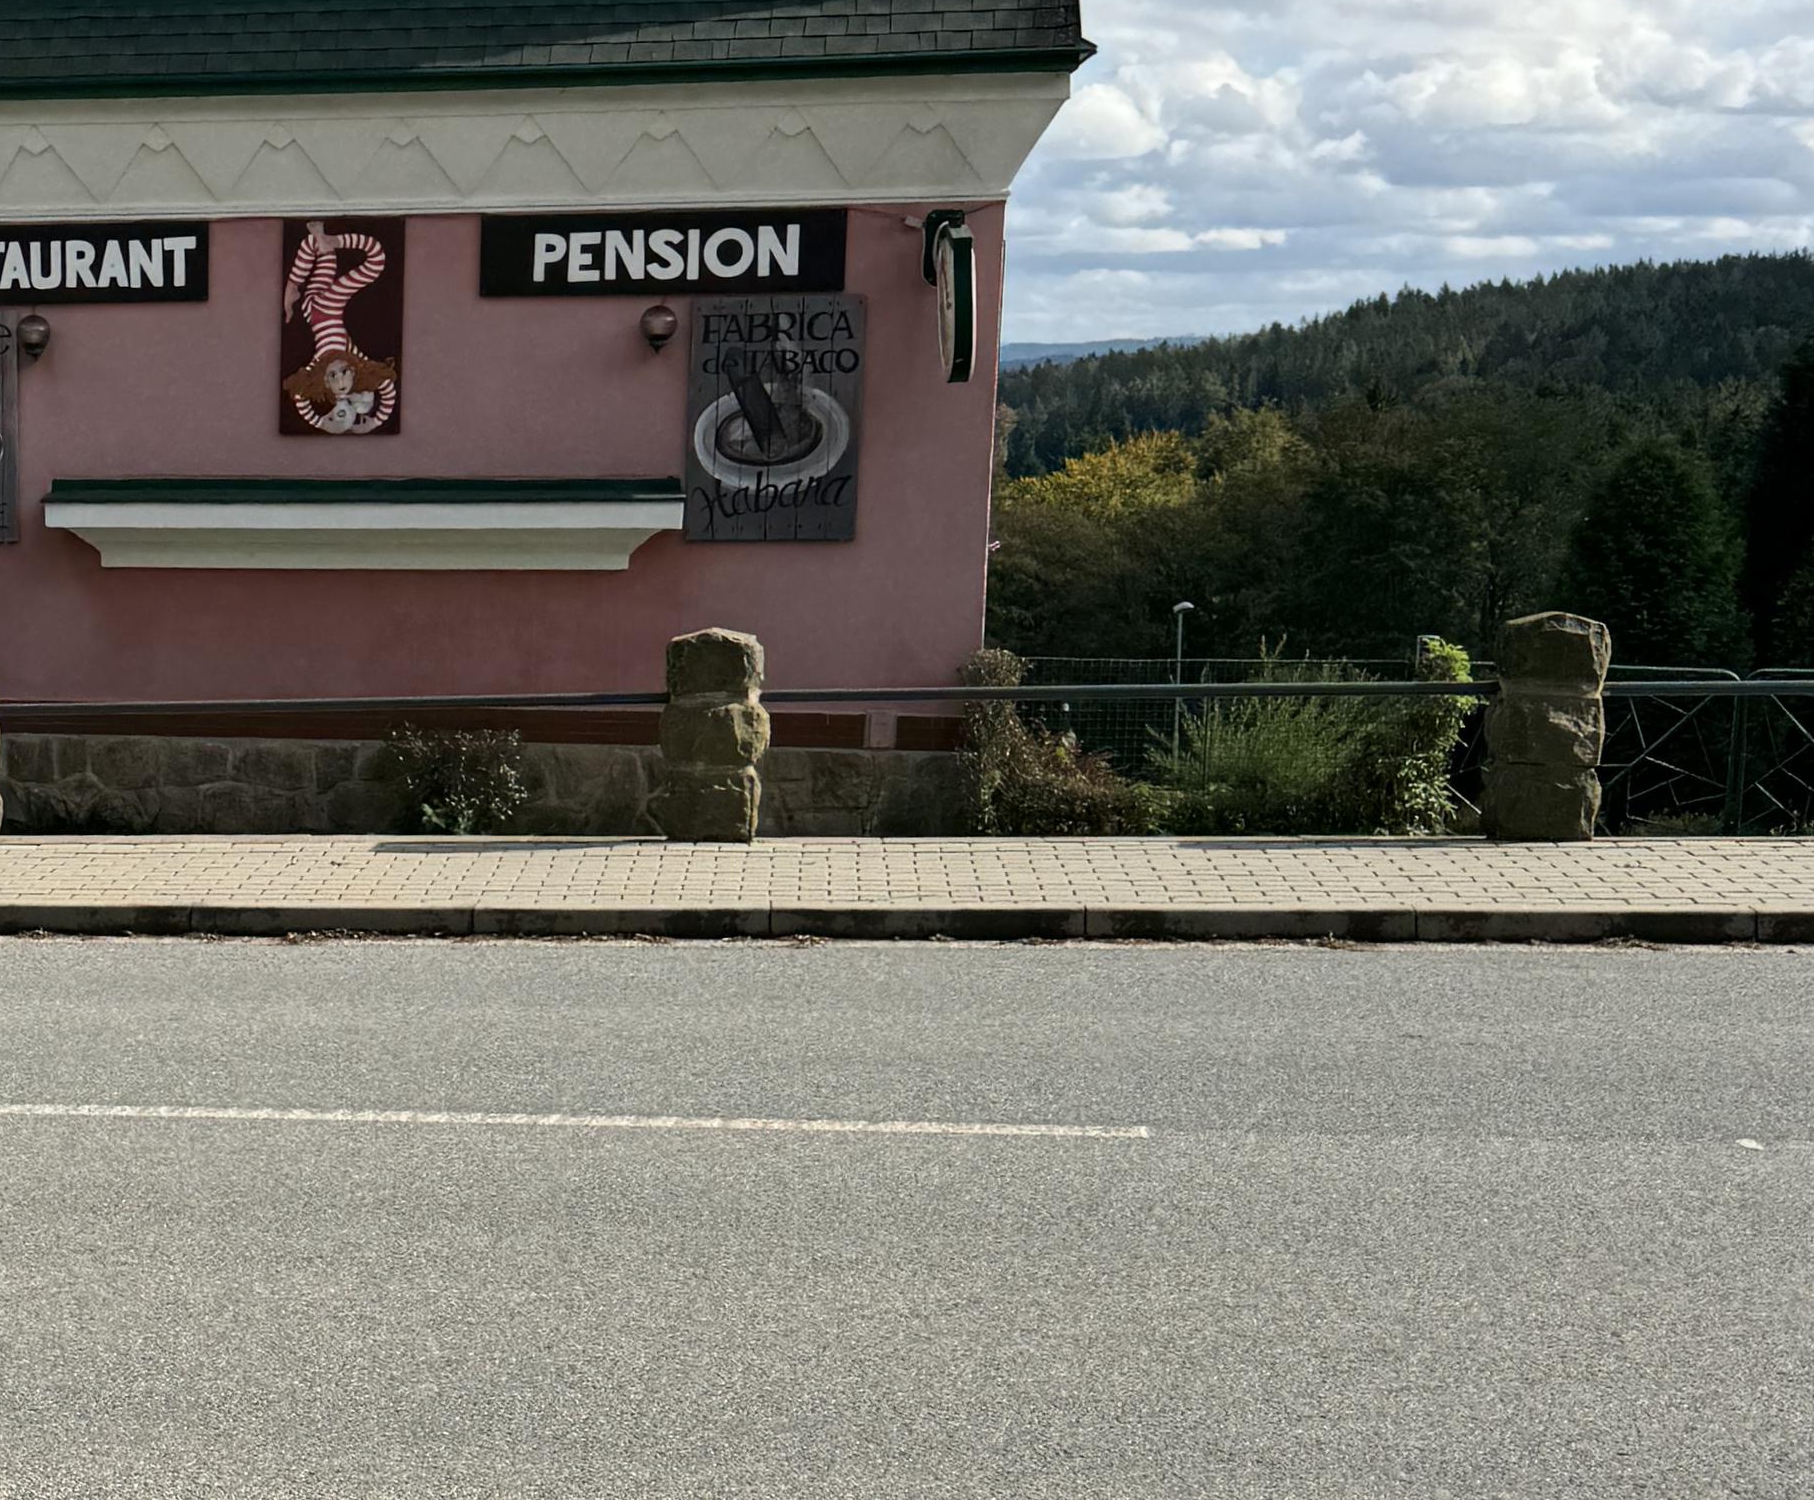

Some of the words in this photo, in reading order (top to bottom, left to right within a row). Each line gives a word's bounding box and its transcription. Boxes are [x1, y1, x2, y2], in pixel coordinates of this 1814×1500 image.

[533, 224, 800, 282] PENSION
[702, 310, 855, 344] FABRICA
[746, 348, 860, 375] TABACO
